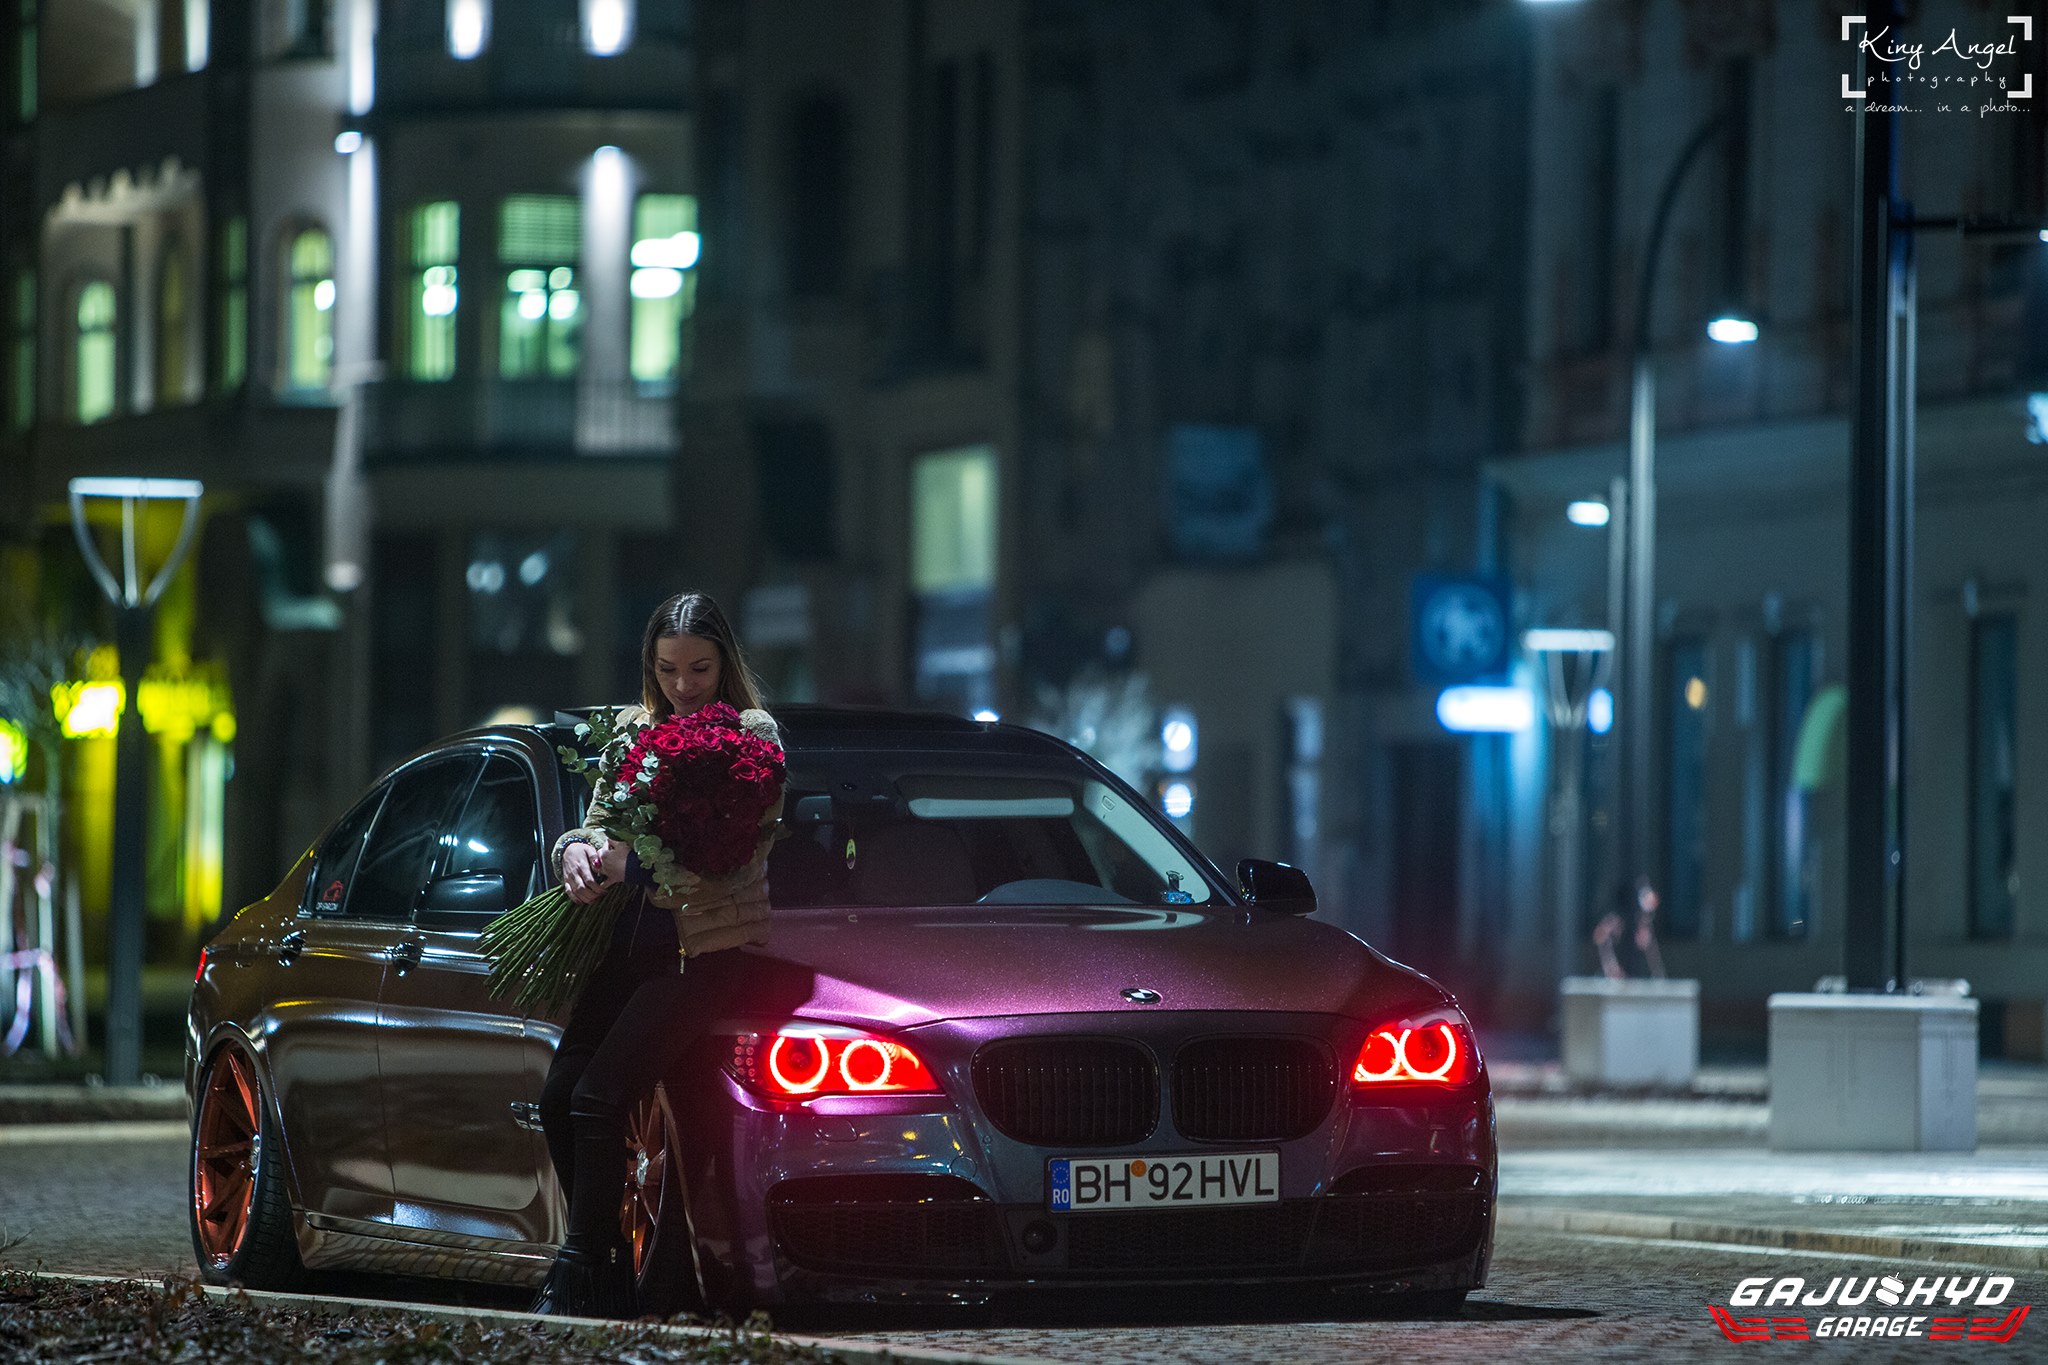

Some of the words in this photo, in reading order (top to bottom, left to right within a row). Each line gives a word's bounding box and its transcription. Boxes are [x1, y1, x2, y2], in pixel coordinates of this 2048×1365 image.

[1053, 1188, 1070, 1205] RO
[1075, 1163, 1131, 1204] BH
[1148, 1161, 1193, 1201] 92
[1200, 1157, 1275, 1199] HVL
